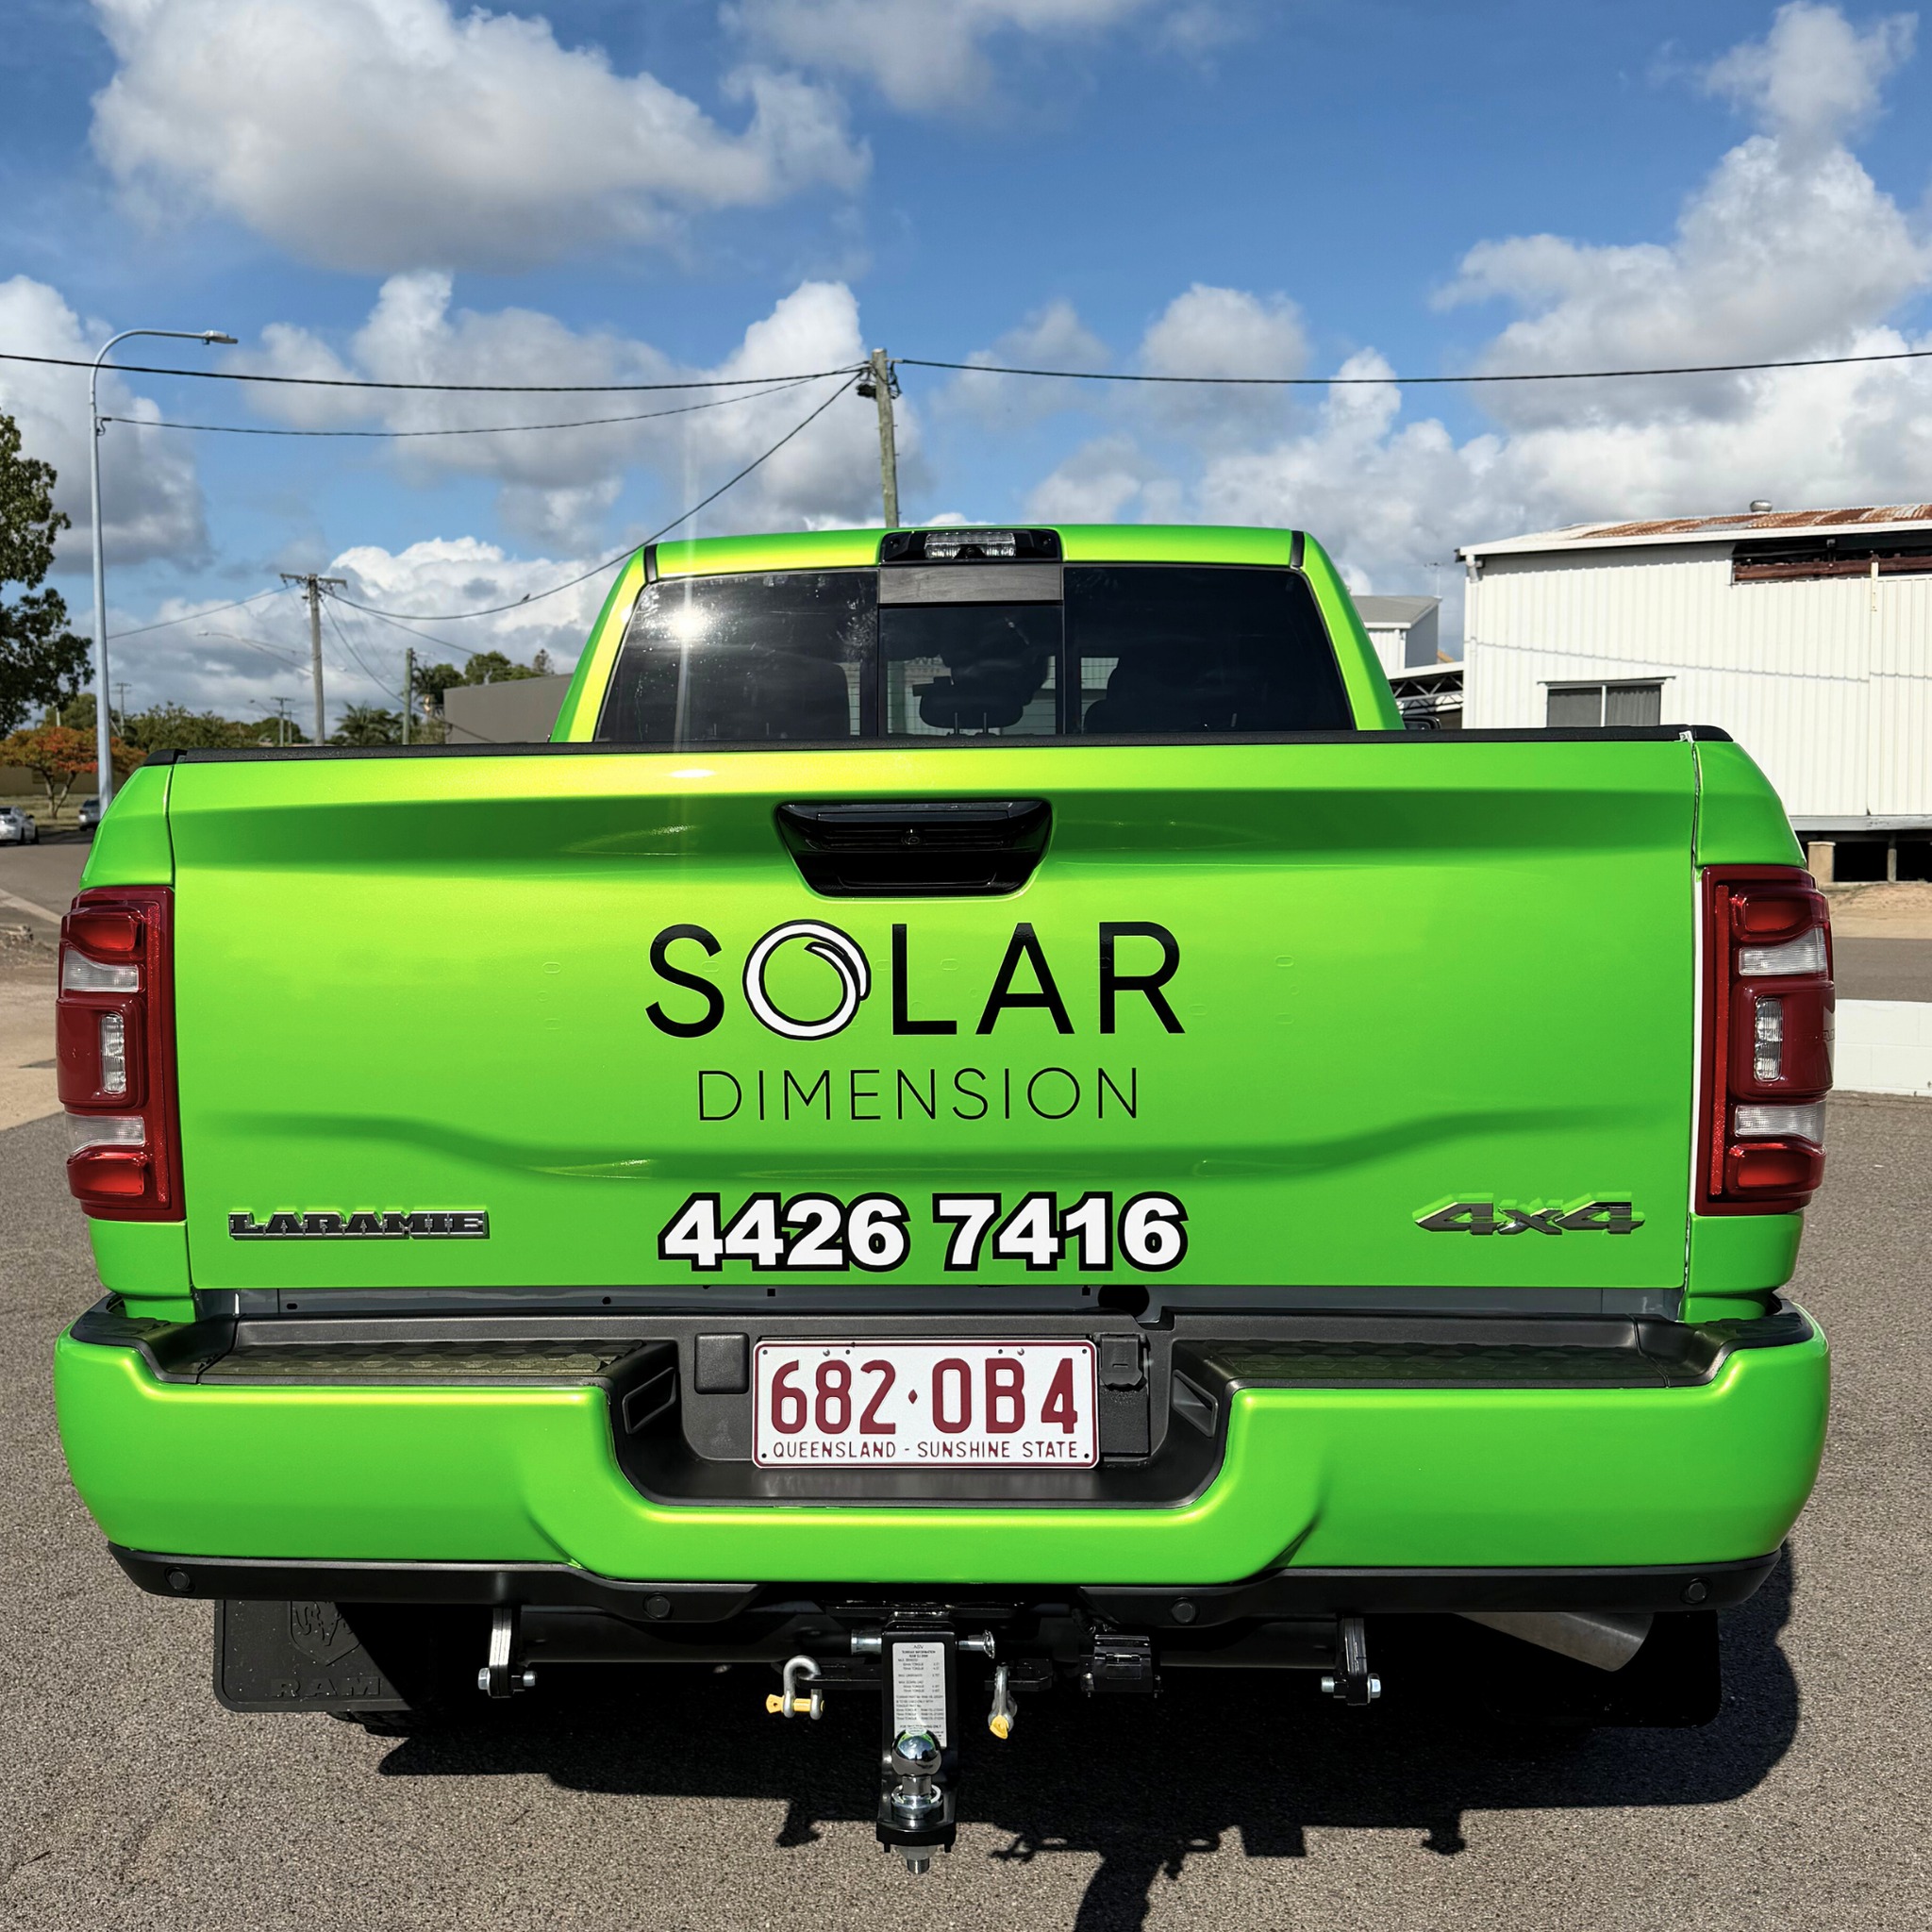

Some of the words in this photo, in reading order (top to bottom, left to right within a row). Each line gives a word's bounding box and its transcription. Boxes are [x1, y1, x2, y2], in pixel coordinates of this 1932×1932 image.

[645, 919, 1186, 1041] SOLAR
[698, 1067, 1139, 1122] DIMENSION
[228, 1210, 491, 1241] LARAMIE
[658, 1191, 911, 1273] 4426
[932, 1191, 1189, 1273] 7416
[773, 1441, 896, 1459] QUEENSLAND
[917, 1441, 1011, 1459] SUNSHINE
[1023, 1441, 1077, 1459] STATE
